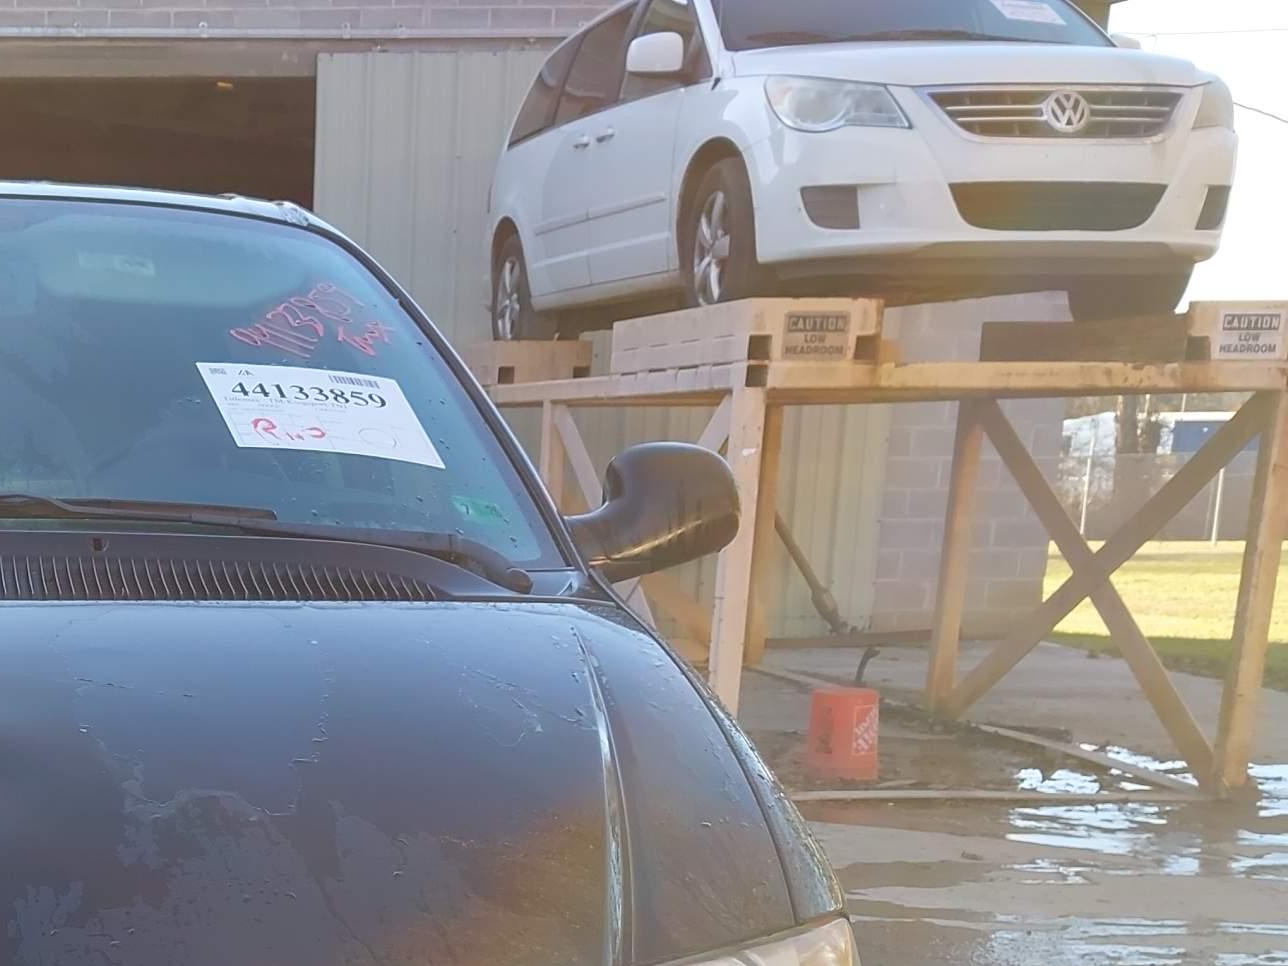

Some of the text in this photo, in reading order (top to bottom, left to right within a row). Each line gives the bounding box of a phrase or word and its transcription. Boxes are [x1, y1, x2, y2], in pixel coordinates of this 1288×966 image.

[790, 316, 845, 330] CAUTION
[1223, 316, 1279, 329] CAUTION
[804, 334, 826, 344] LOW
[1238, 332, 1261, 342] LOW
[1219, 343, 1276, 353] HEADROOM
[231, 381, 387, 409] 44133859
